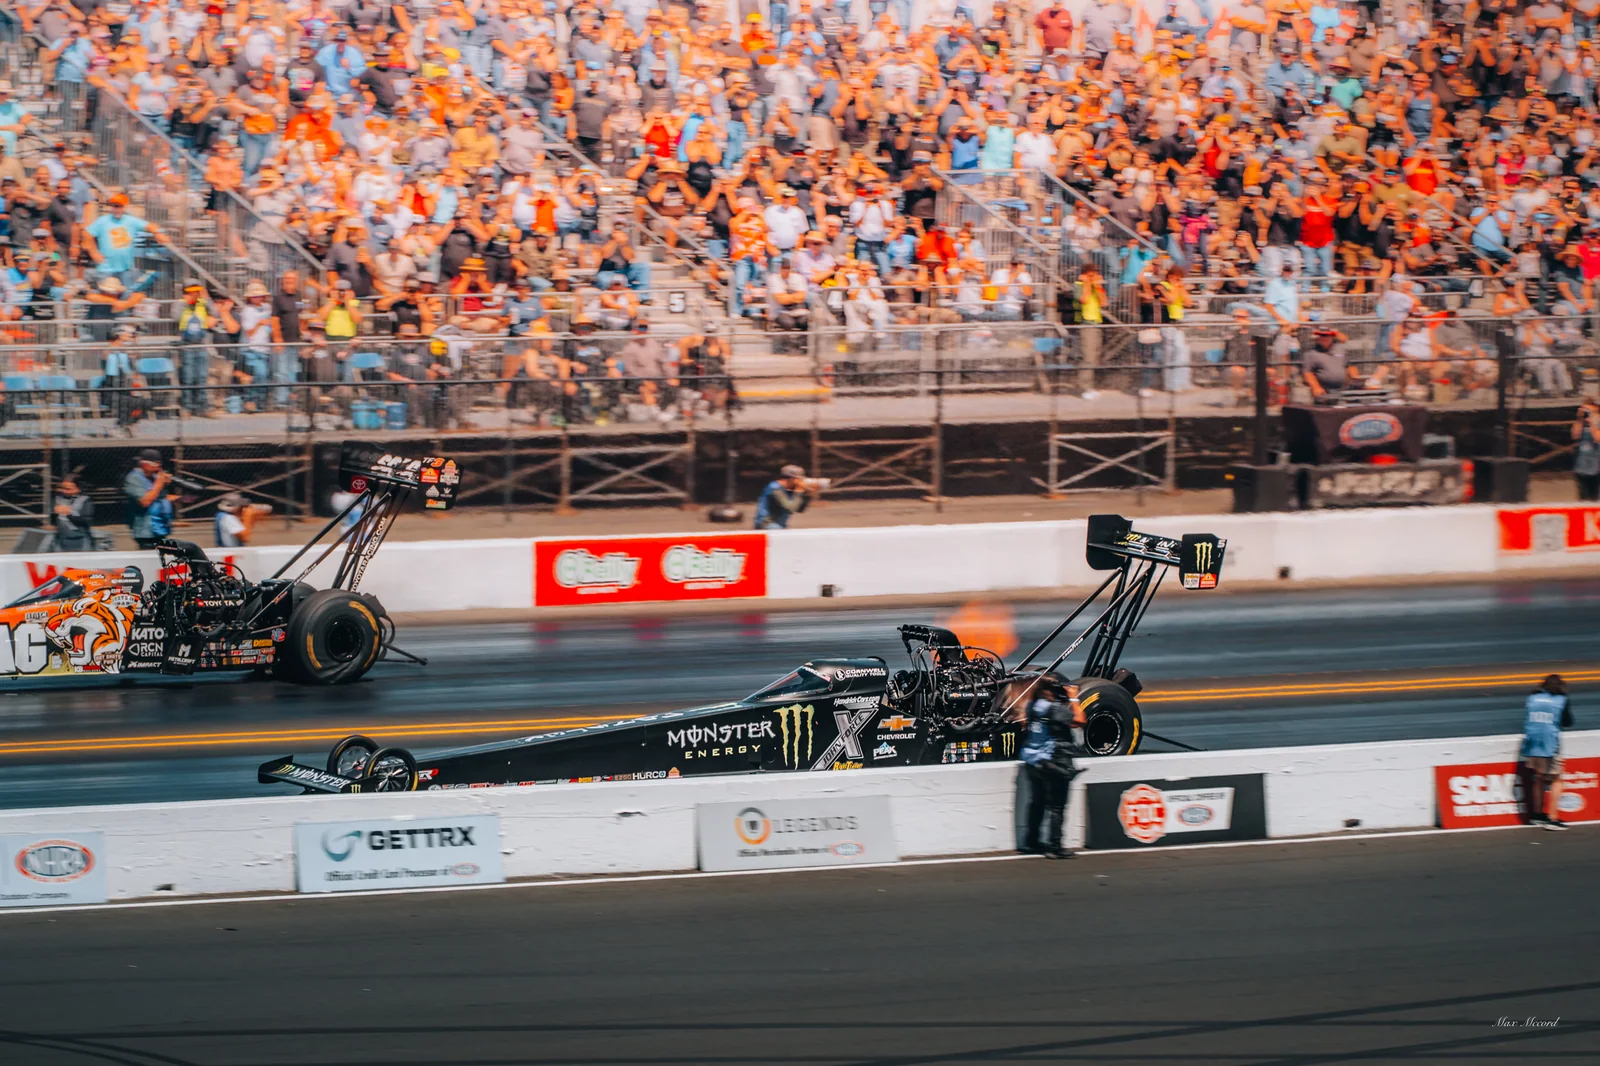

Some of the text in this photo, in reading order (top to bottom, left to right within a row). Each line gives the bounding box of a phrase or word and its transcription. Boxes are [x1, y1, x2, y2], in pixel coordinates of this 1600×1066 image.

[131, 627, 165, 640] KATO
[140, 642, 163, 651] RCN
[667, 720, 776, 748] MONSTER
[823, 715, 865, 766] JOHN FORCE
[877, 733, 916, 741] CHEVROLET
[685, 744, 761, 759] ENERGY
[873, 744, 897, 757] PEAK
[289, 767, 352, 789] MONSTER
[632, 770, 667, 780] HURCO
[369, 826, 476, 851] GETTRX
